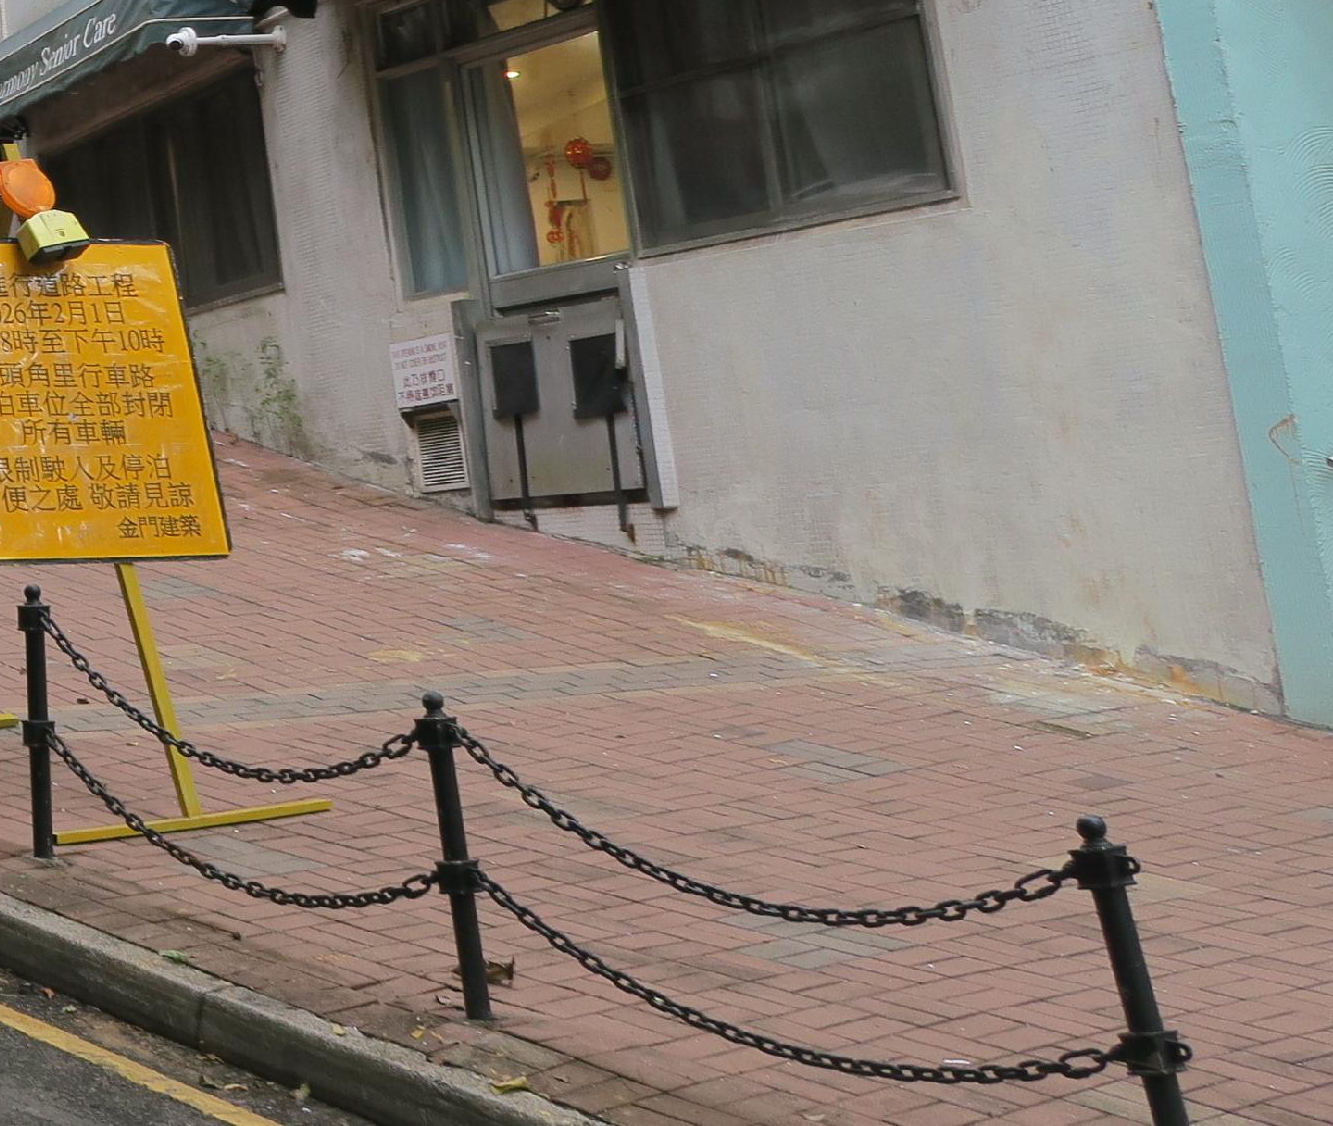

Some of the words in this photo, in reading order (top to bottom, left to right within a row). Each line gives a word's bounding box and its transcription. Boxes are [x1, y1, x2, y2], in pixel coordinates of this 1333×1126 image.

[39, 34, 81, 76] Senior
[83, 13, 117, 48] Care
[21, 419, 128, 446] 所有車輛
[88, 482, 196, 510] 敬請見諒
[116, 514, 203, 539] 金門建築
